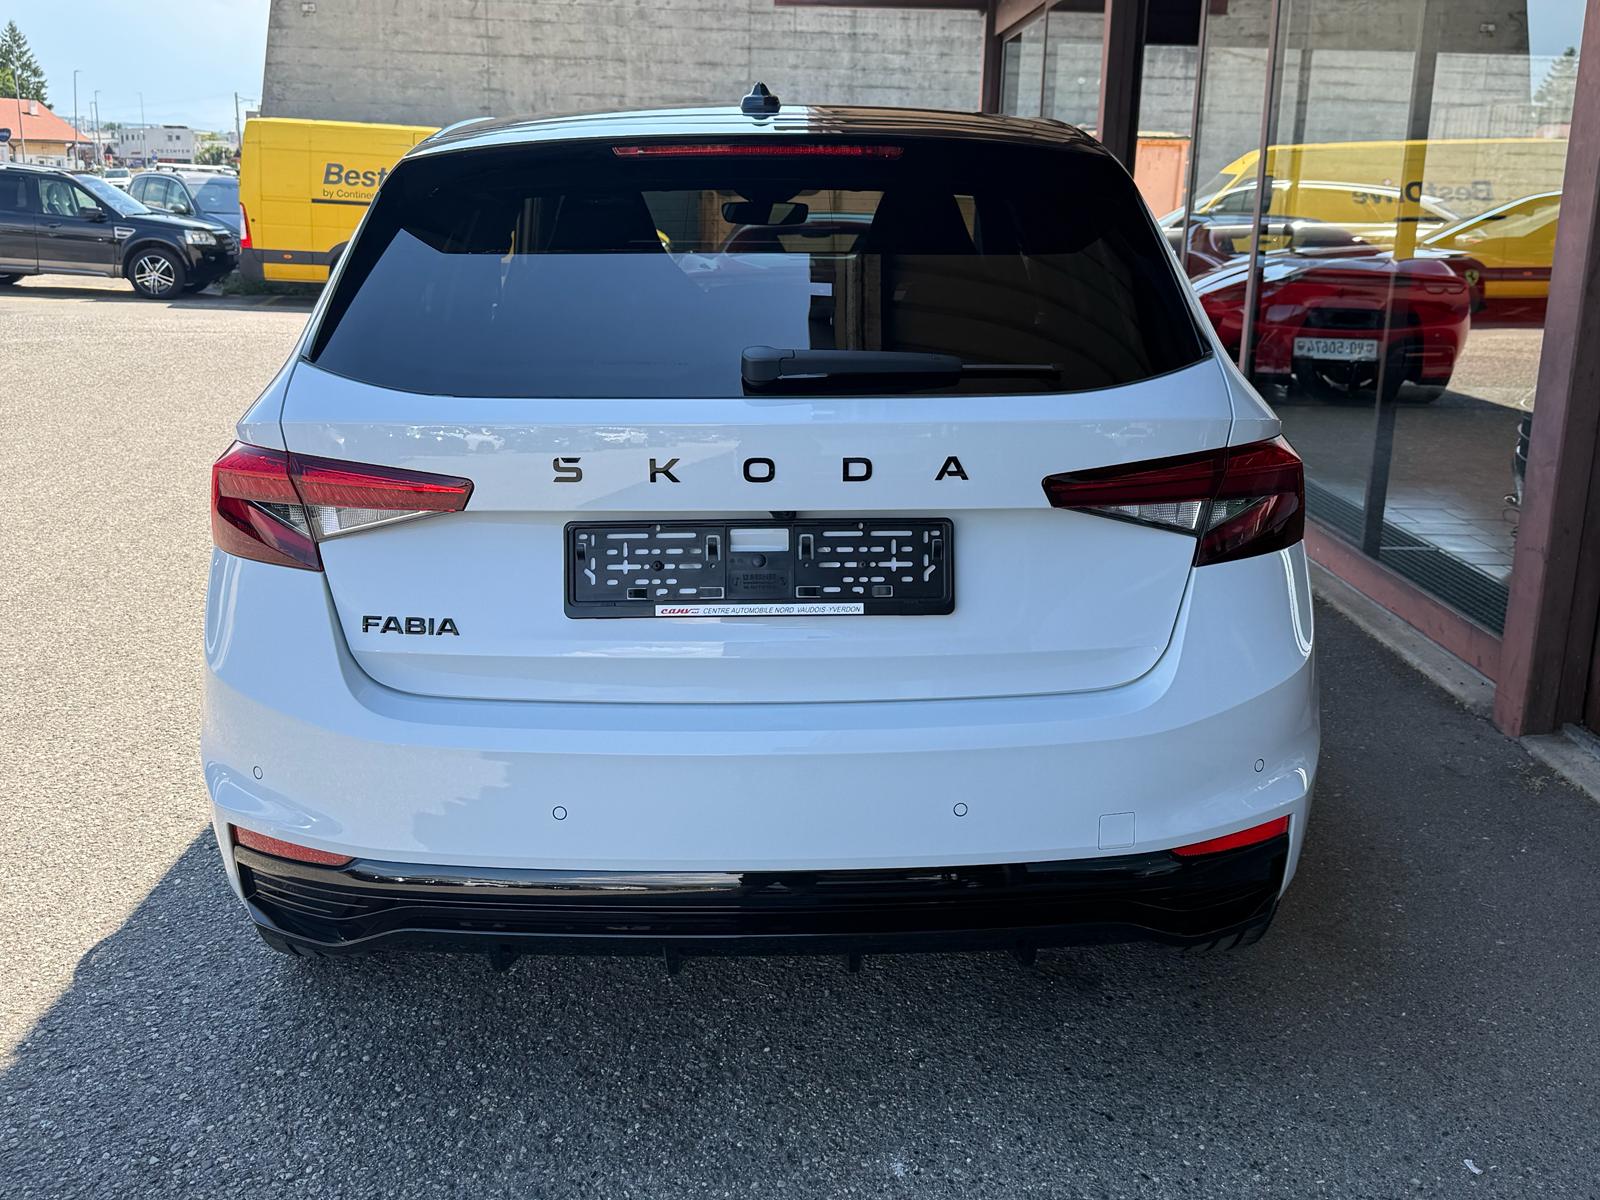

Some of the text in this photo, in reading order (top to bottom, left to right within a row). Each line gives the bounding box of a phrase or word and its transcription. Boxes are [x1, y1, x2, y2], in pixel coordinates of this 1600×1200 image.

[323, 163, 388, 187] Best
[322, 188, 334, 199] by
[702, 607, 731, 615] CENTRE
[775, 606, 795, 614] NORD
[362, 615, 460, 636] FABIA
